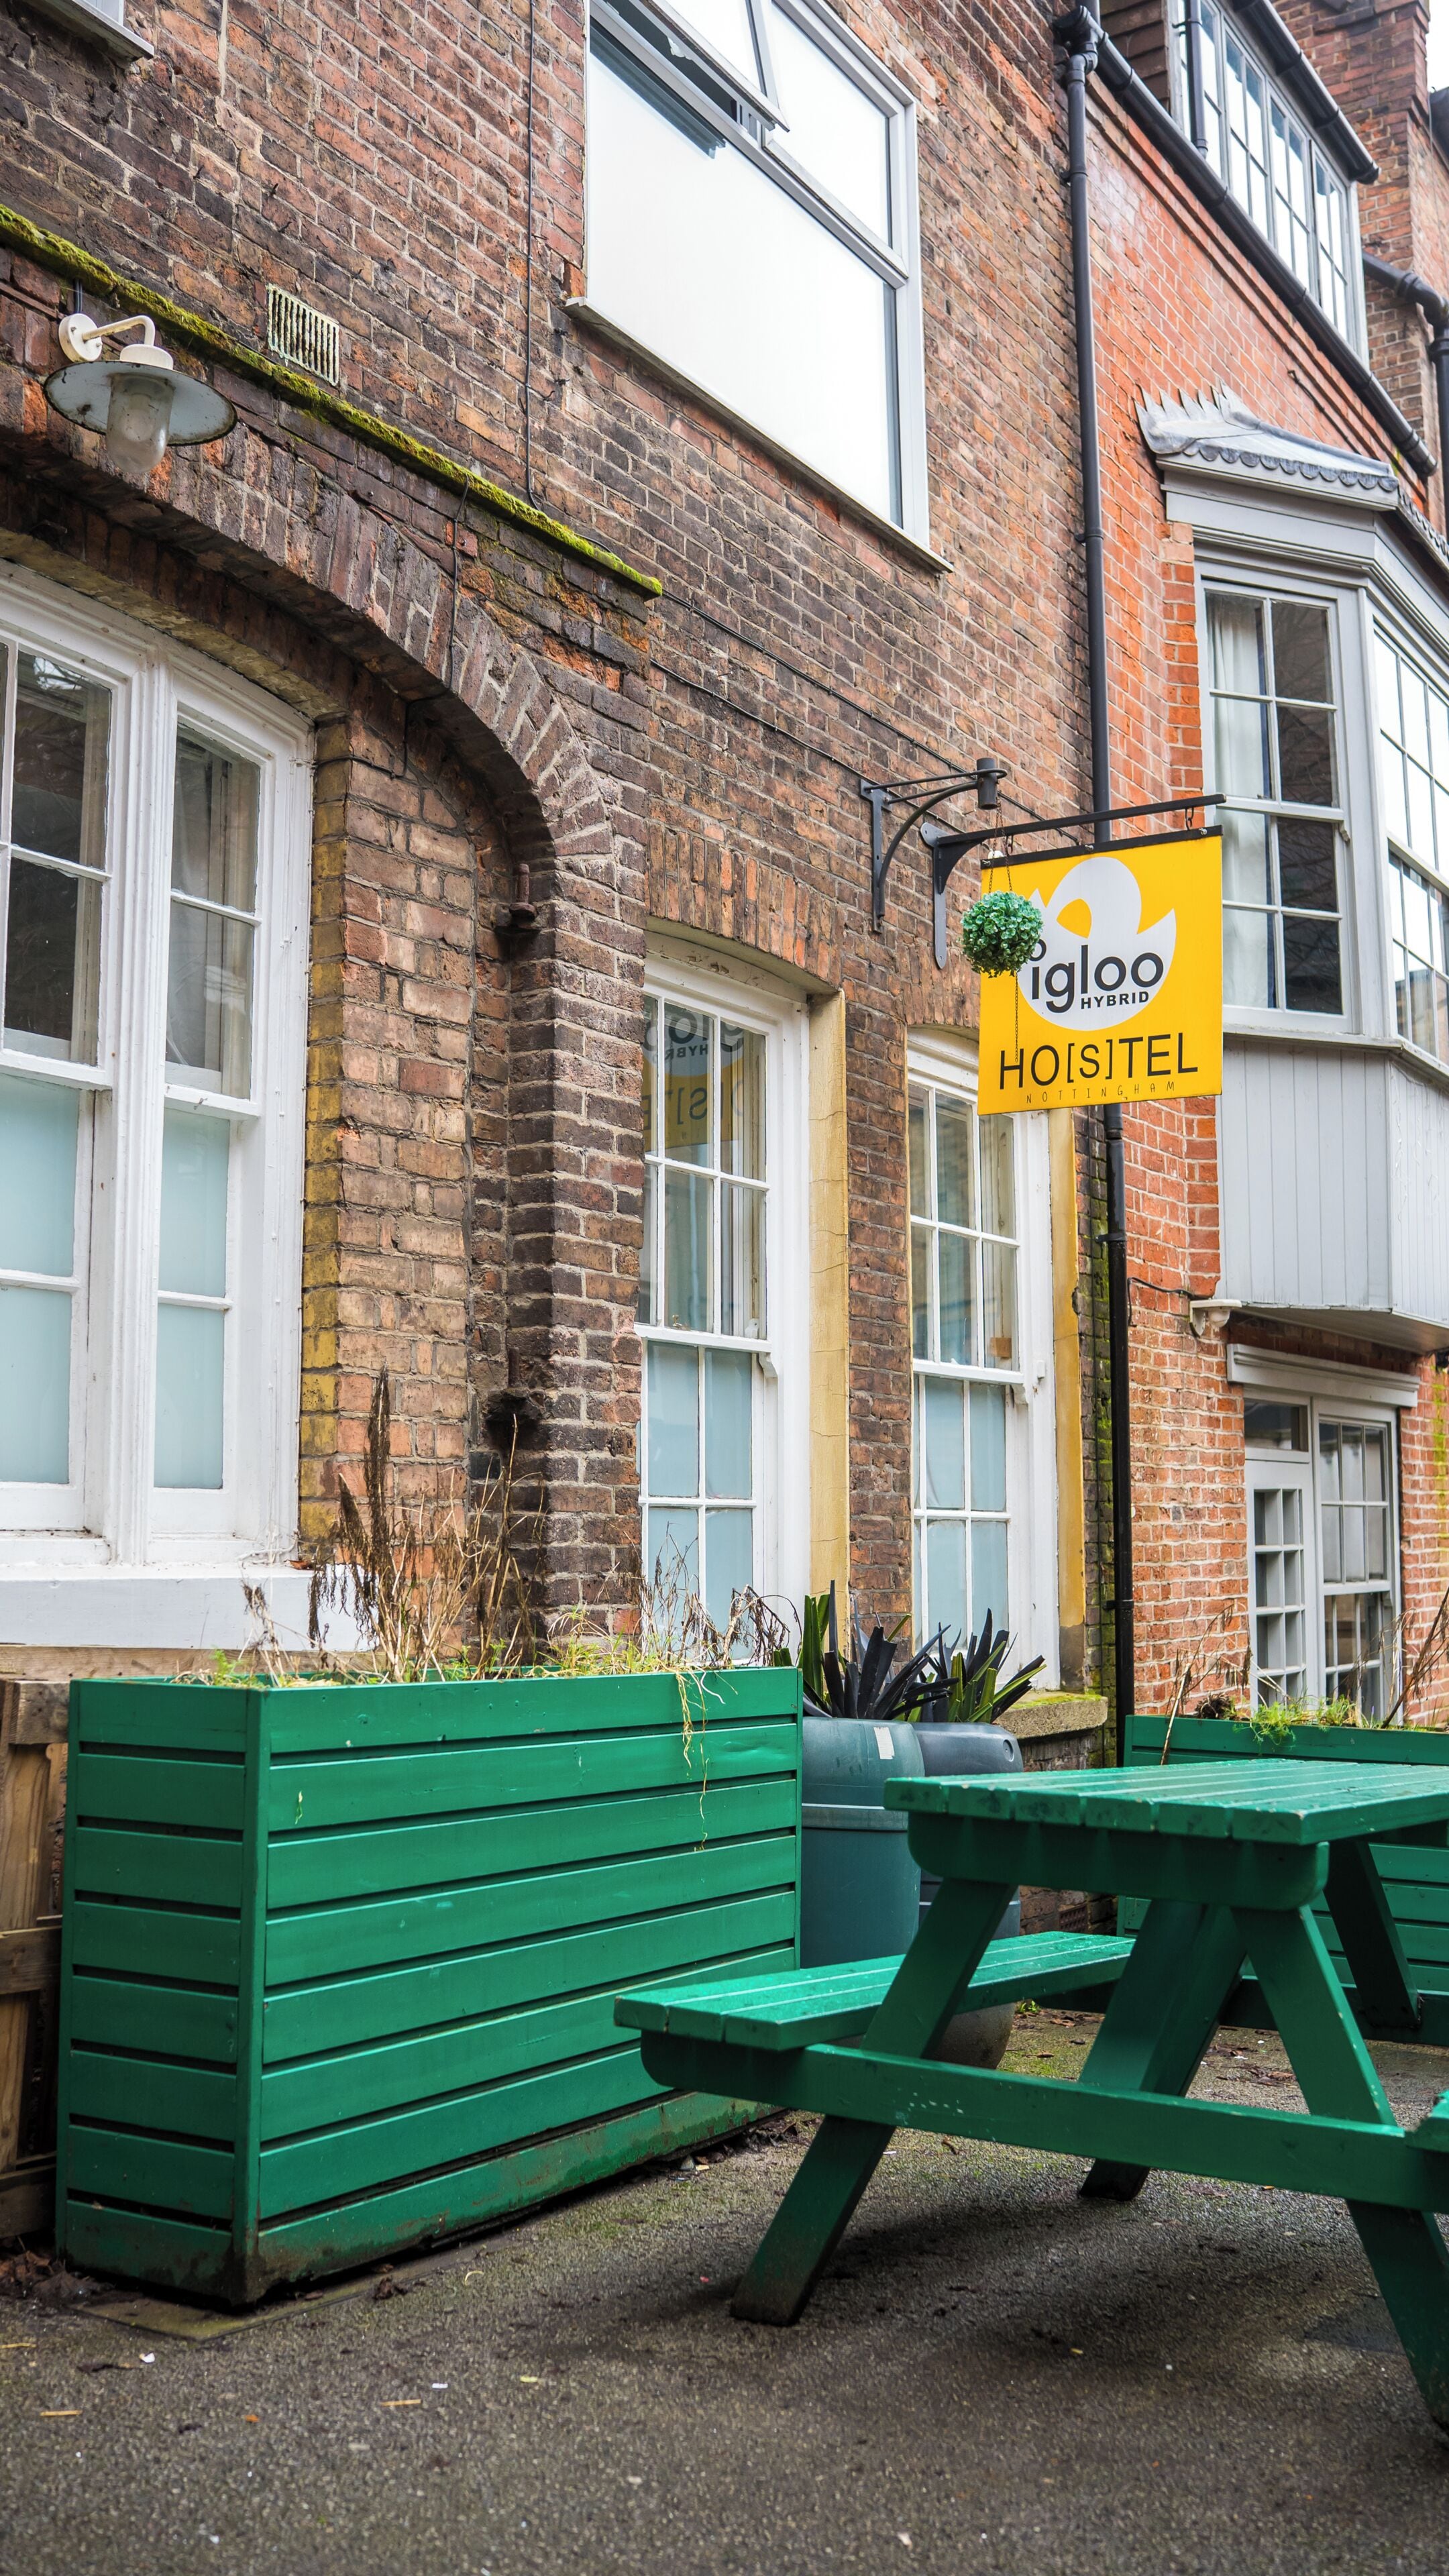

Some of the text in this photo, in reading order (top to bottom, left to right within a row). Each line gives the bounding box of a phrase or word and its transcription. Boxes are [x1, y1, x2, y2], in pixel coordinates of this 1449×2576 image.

[1030, 939, 1164, 1014] igloo
[1081, 991, 1149, 1010] HYBRID
[1000, 1032, 1198, 1090] HO[S]TEL
[1026, 1081, 1175, 1104] NOTTINGHAM
